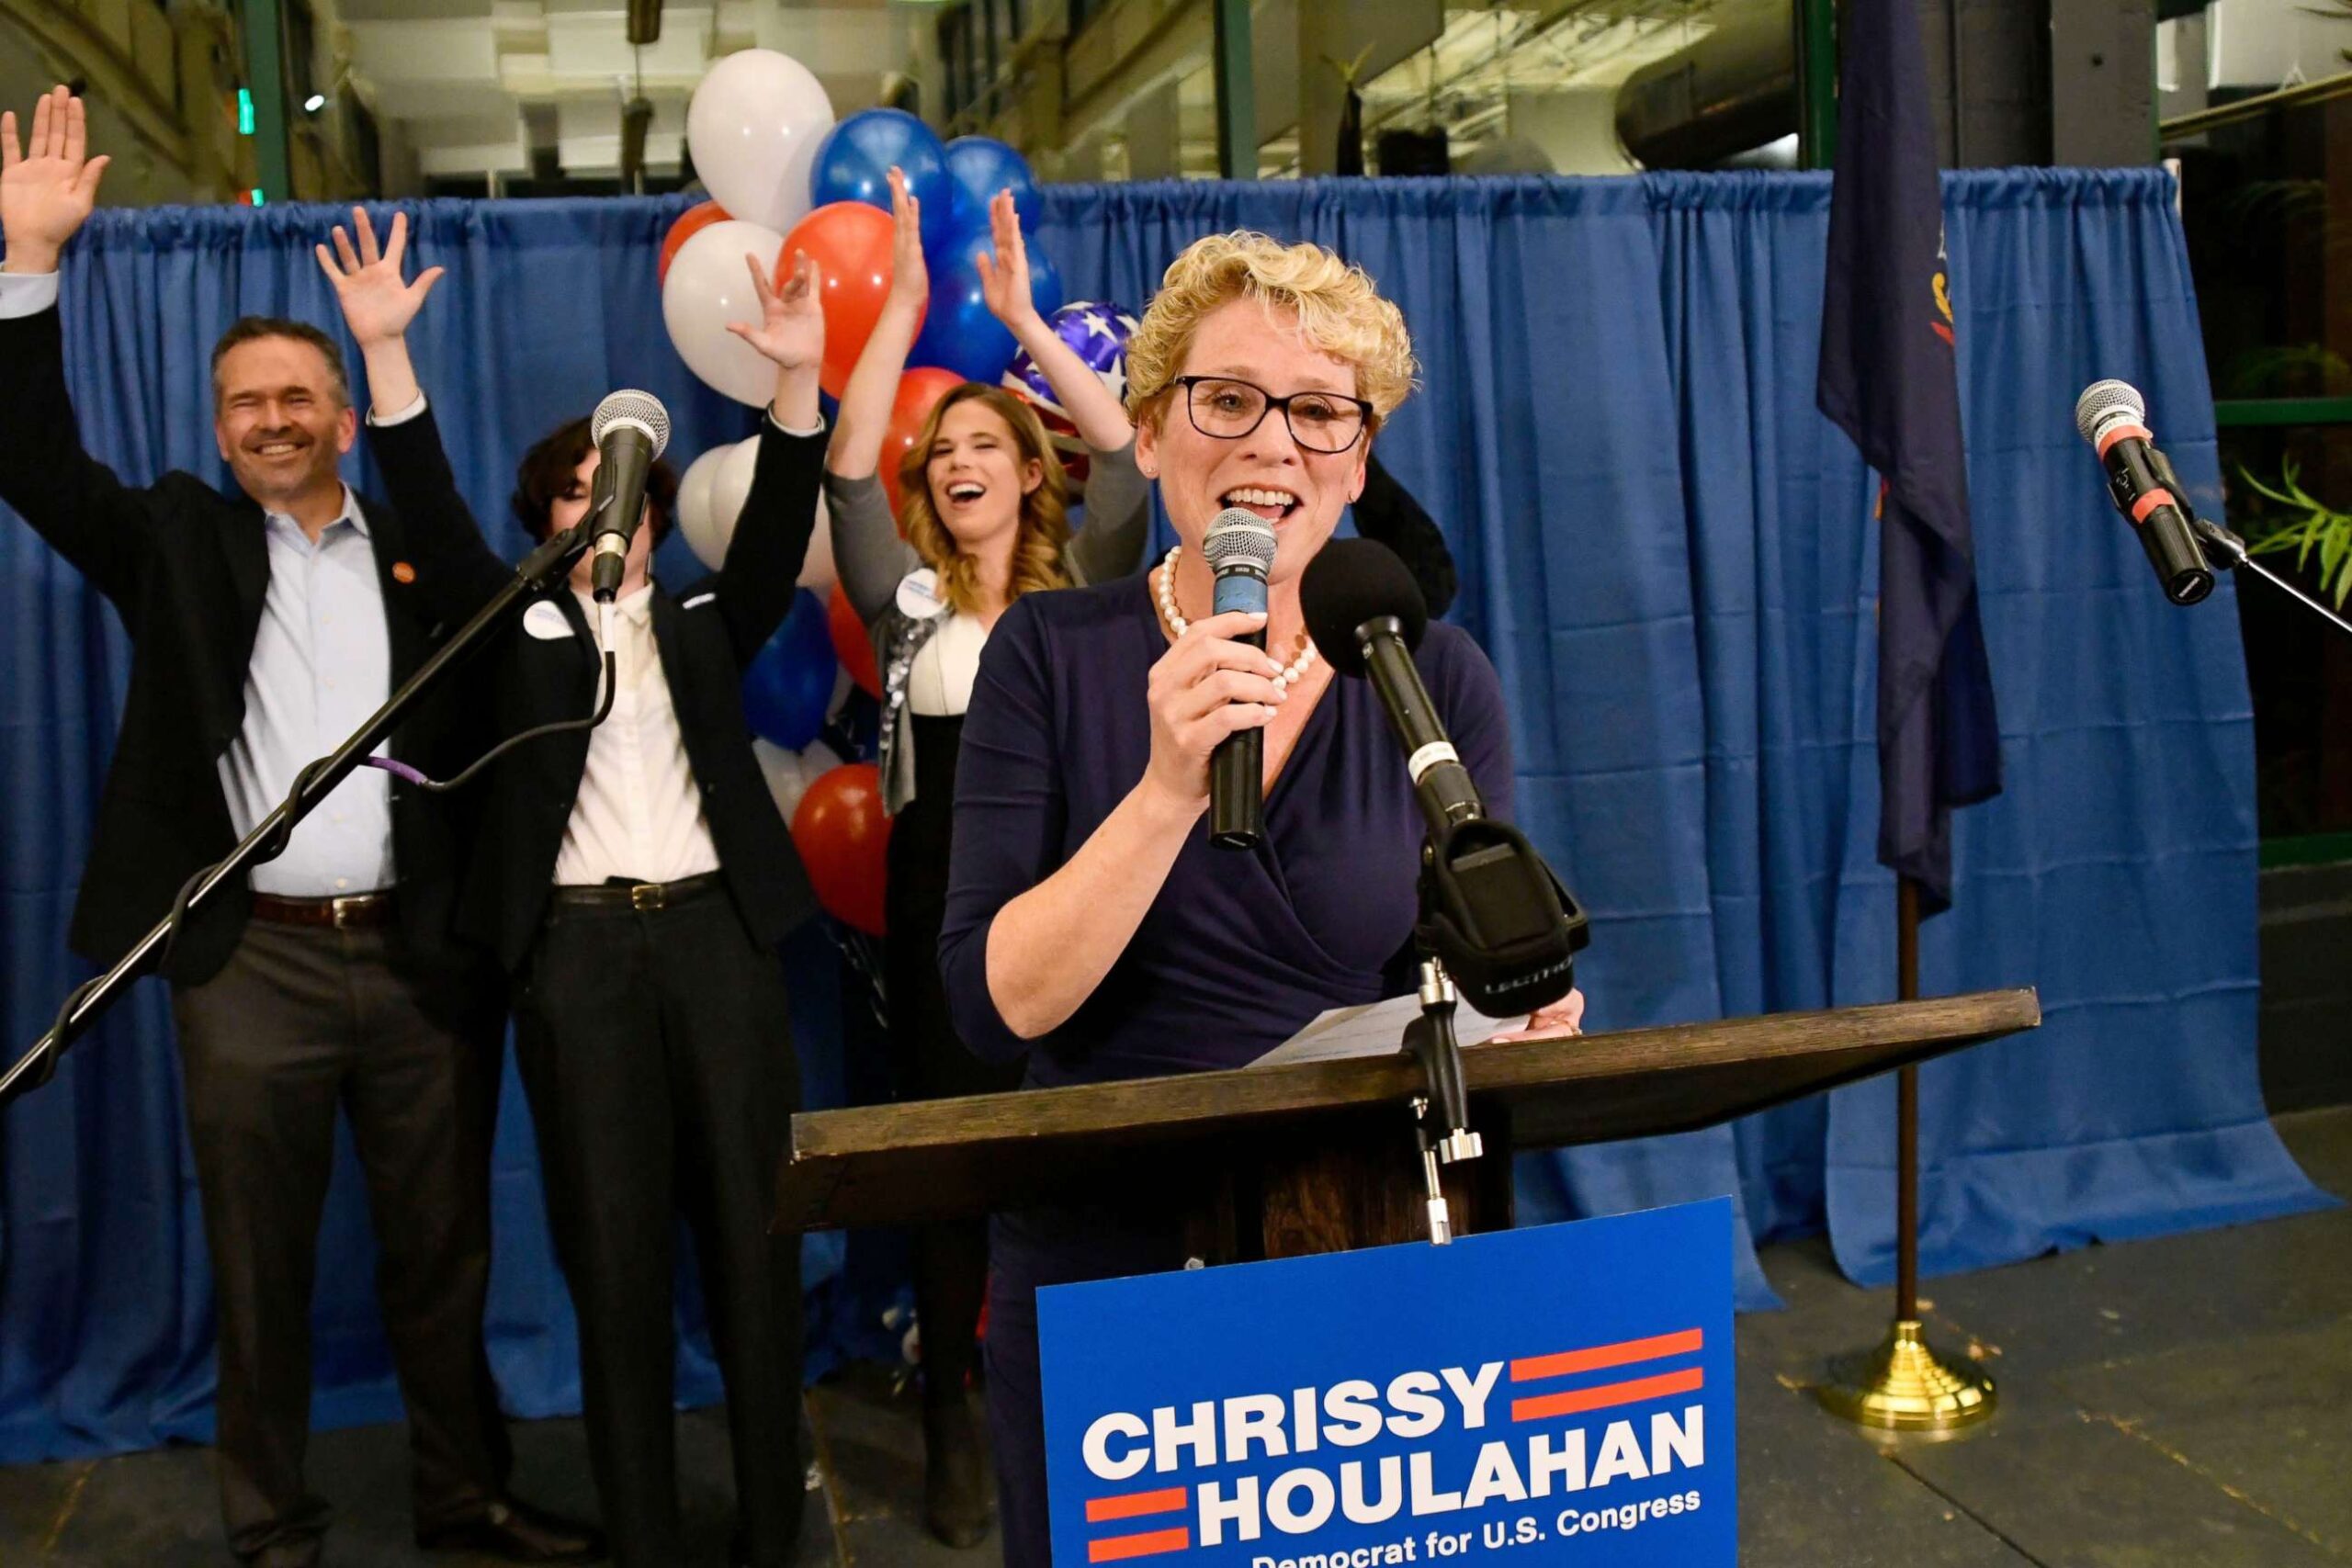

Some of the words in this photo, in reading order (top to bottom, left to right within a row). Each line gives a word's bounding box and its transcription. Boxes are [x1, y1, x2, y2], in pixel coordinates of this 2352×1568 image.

[1082, 1361, 1505, 1481] CHRISSY
[1197, 1404, 1704, 1547] HOULAHAN
[1425, 1531, 1473, 1558] for
[1483, 1517, 1545, 1549] U.S.
[1556, 1491, 1702, 1536] Congress
